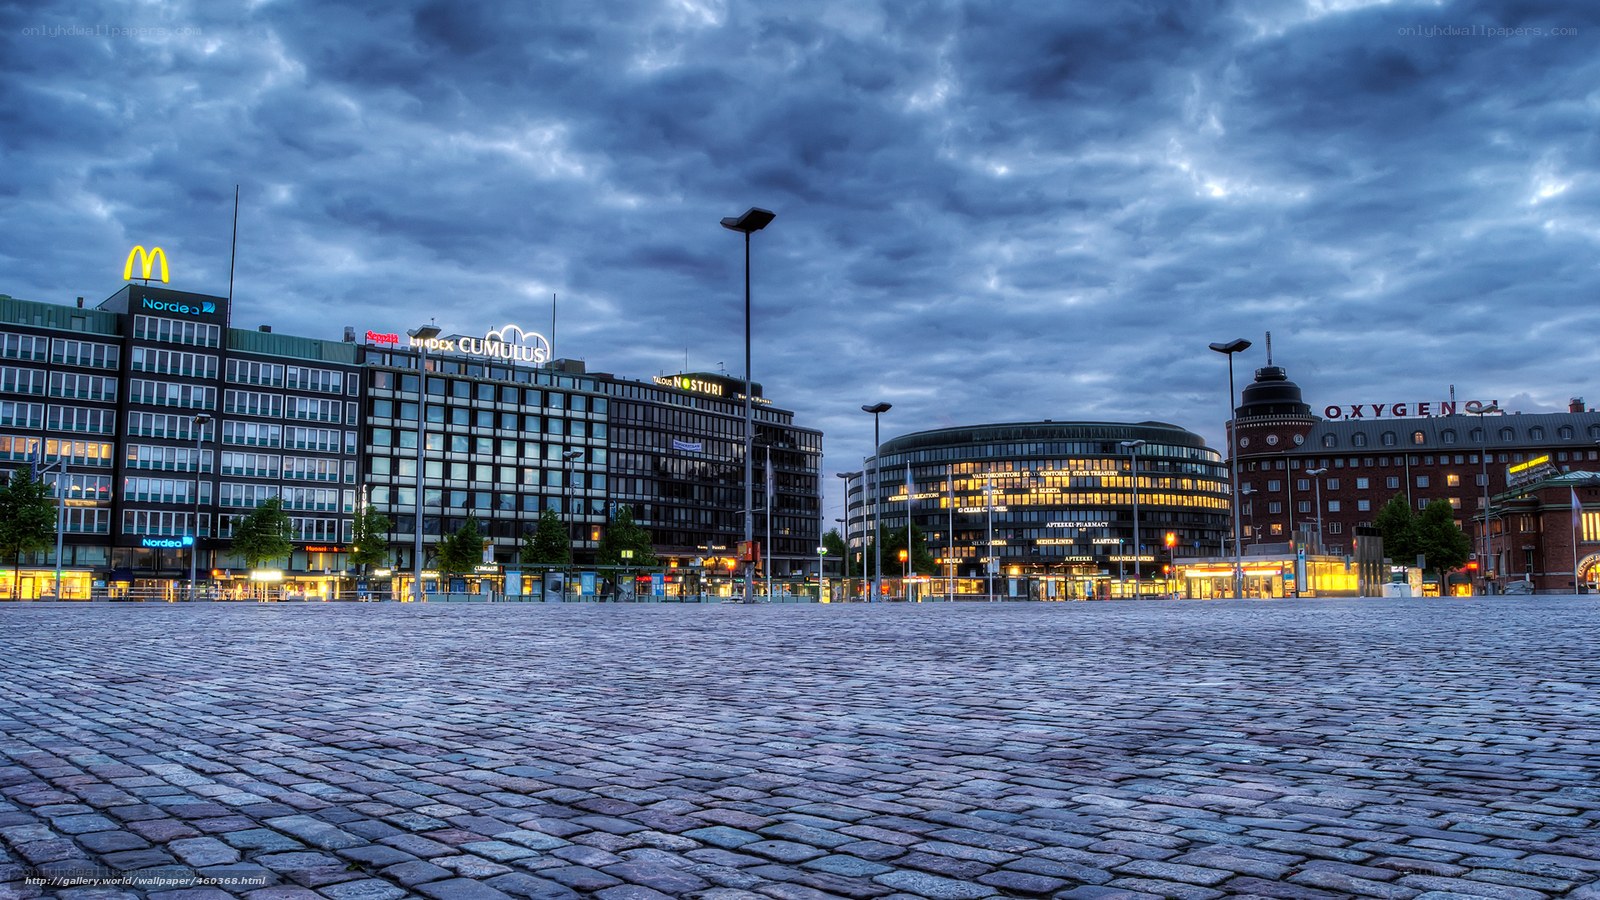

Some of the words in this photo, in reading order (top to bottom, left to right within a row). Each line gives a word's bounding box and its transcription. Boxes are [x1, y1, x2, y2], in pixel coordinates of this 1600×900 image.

[142, 297, 200, 316] Nordea
[458, 336, 546, 364] CUMULUS
[652, 375, 673, 387] TALOUS
[673, 375, 722, 396] NOSTURI
[142, 538, 182, 548] Nordea
